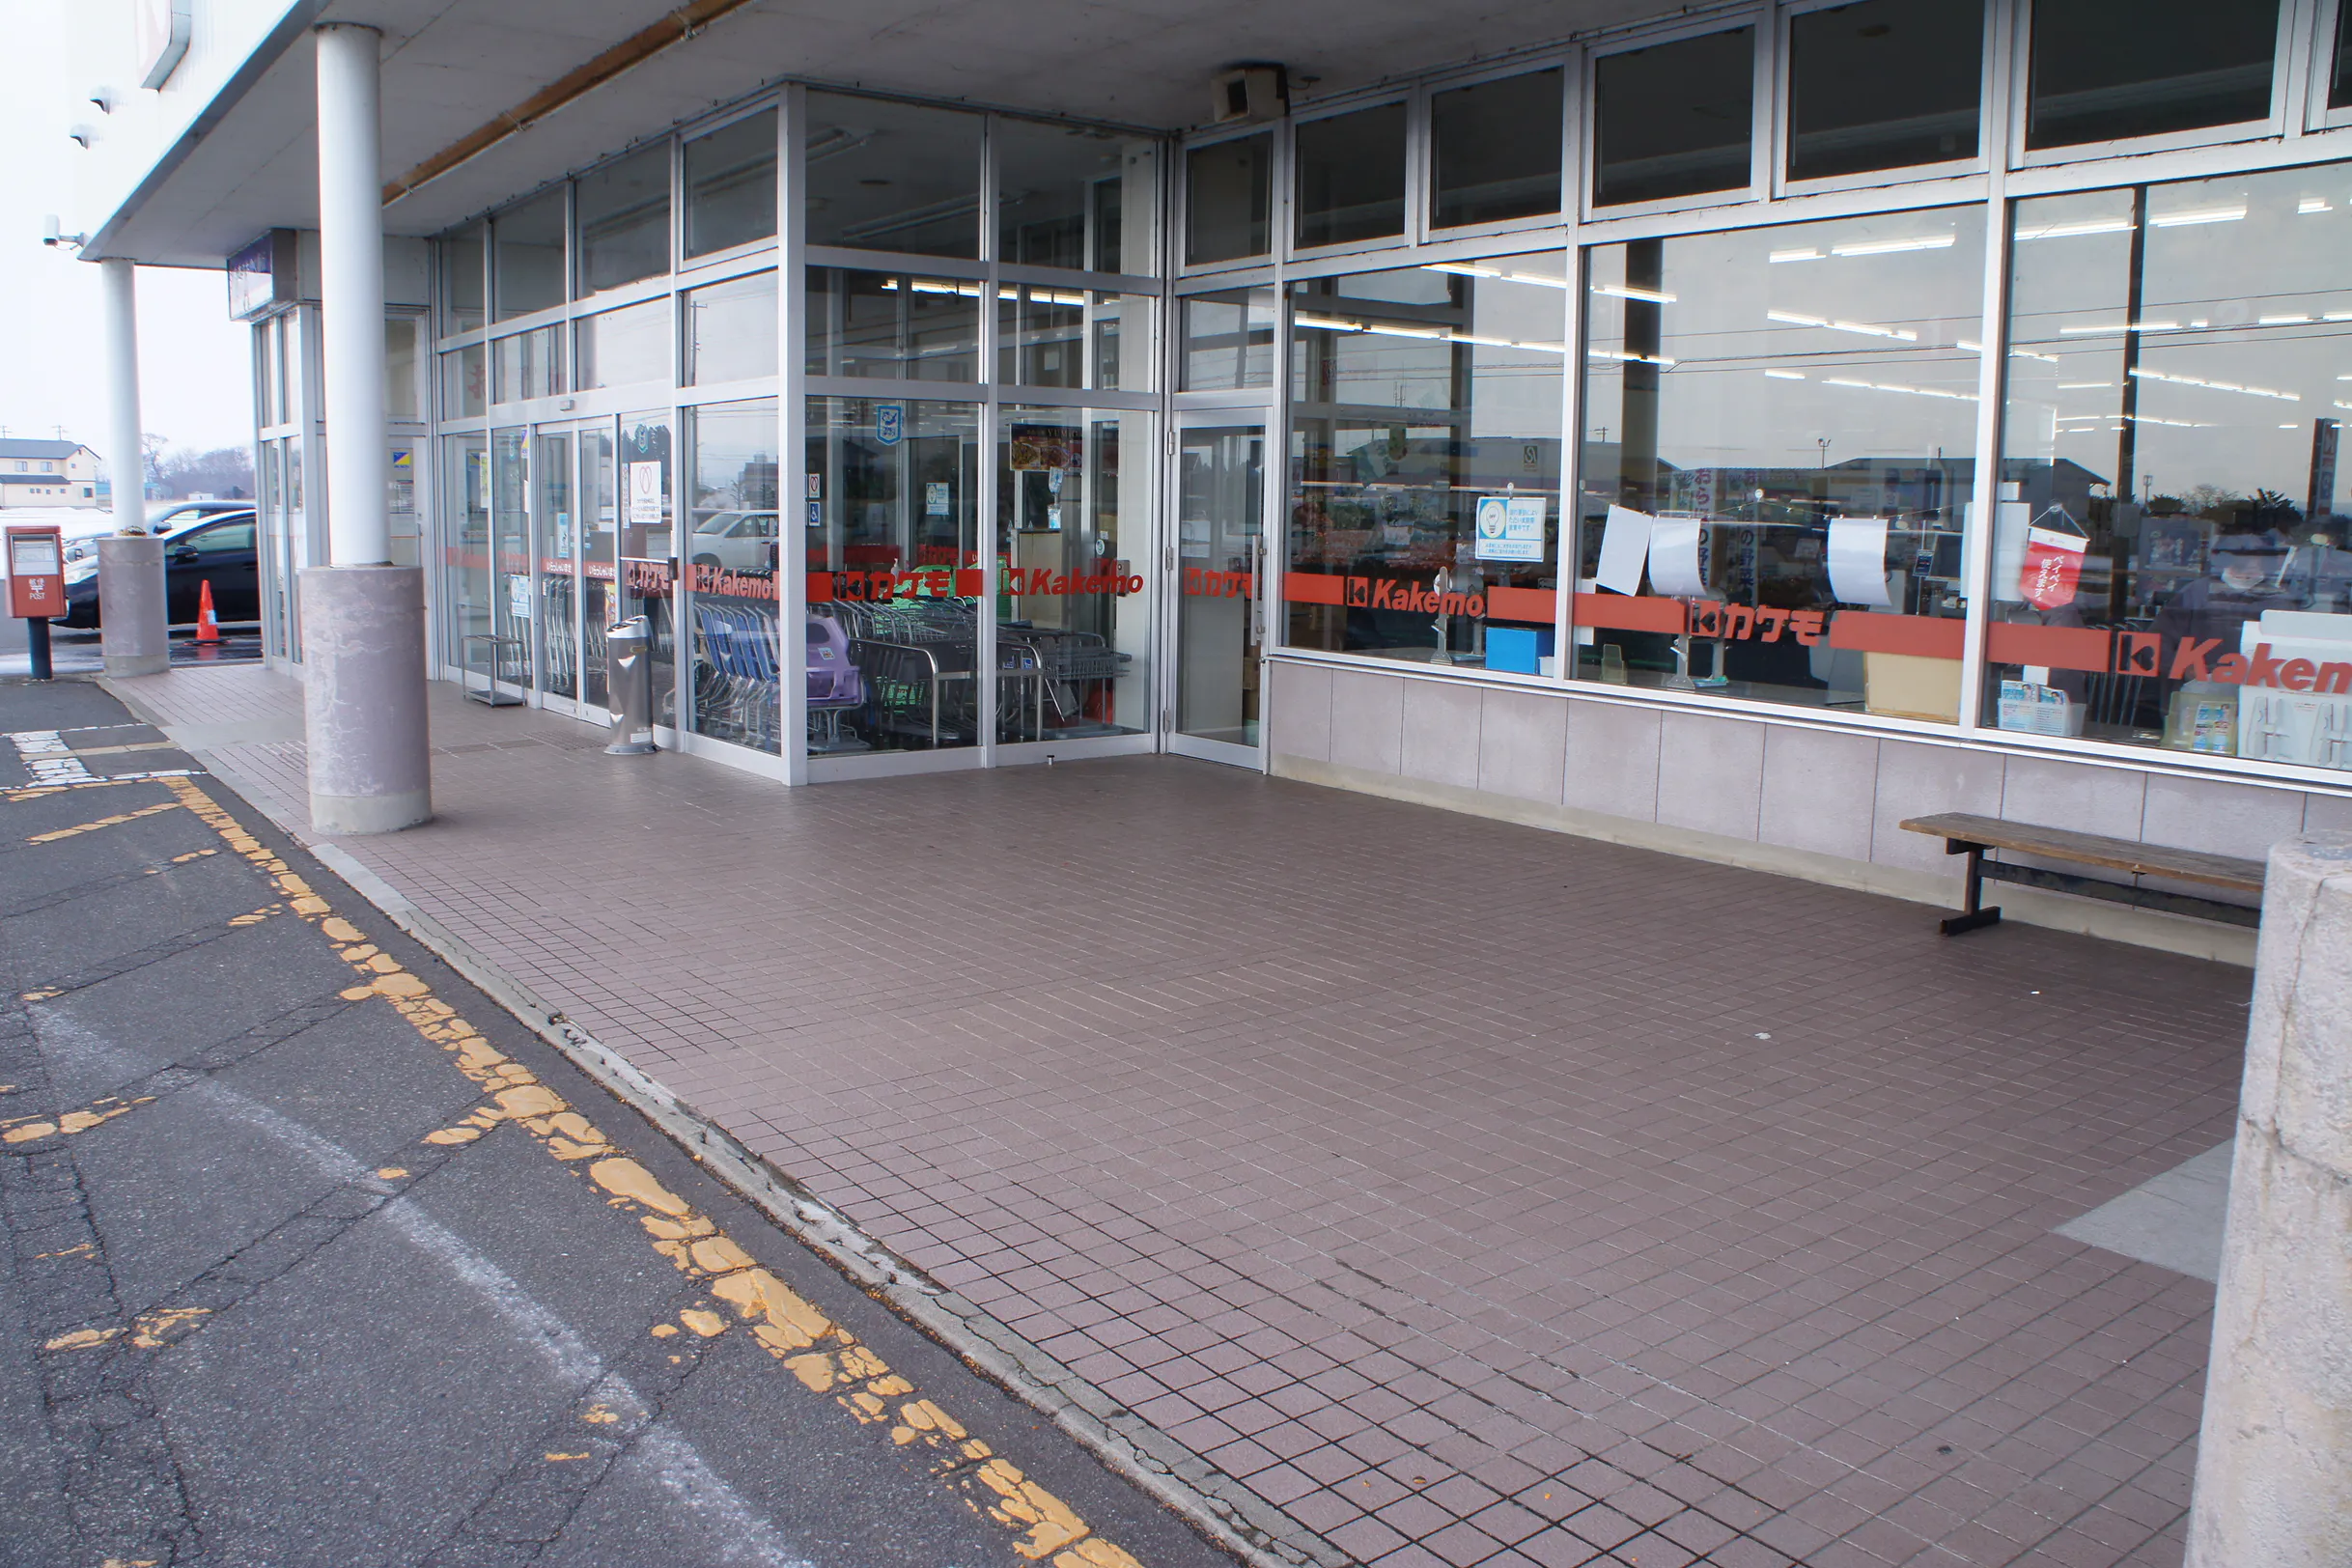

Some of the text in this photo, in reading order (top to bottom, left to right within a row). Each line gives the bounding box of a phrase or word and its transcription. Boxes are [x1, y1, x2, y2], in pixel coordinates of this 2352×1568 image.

[712, 567, 770, 600] Kakemo
[869, 570, 951, 600] カケモ
[1029, 568, 1144, 596] Kakemo
[2034, 558, 2052, 602] 使えます。
[2047, 555, 2065, 593] ペイペイ
[29, 592, 46, 601] POST
[1371, 578, 1485, 618] Kakemo
[1723, 602, 1825, 648] カケモ
